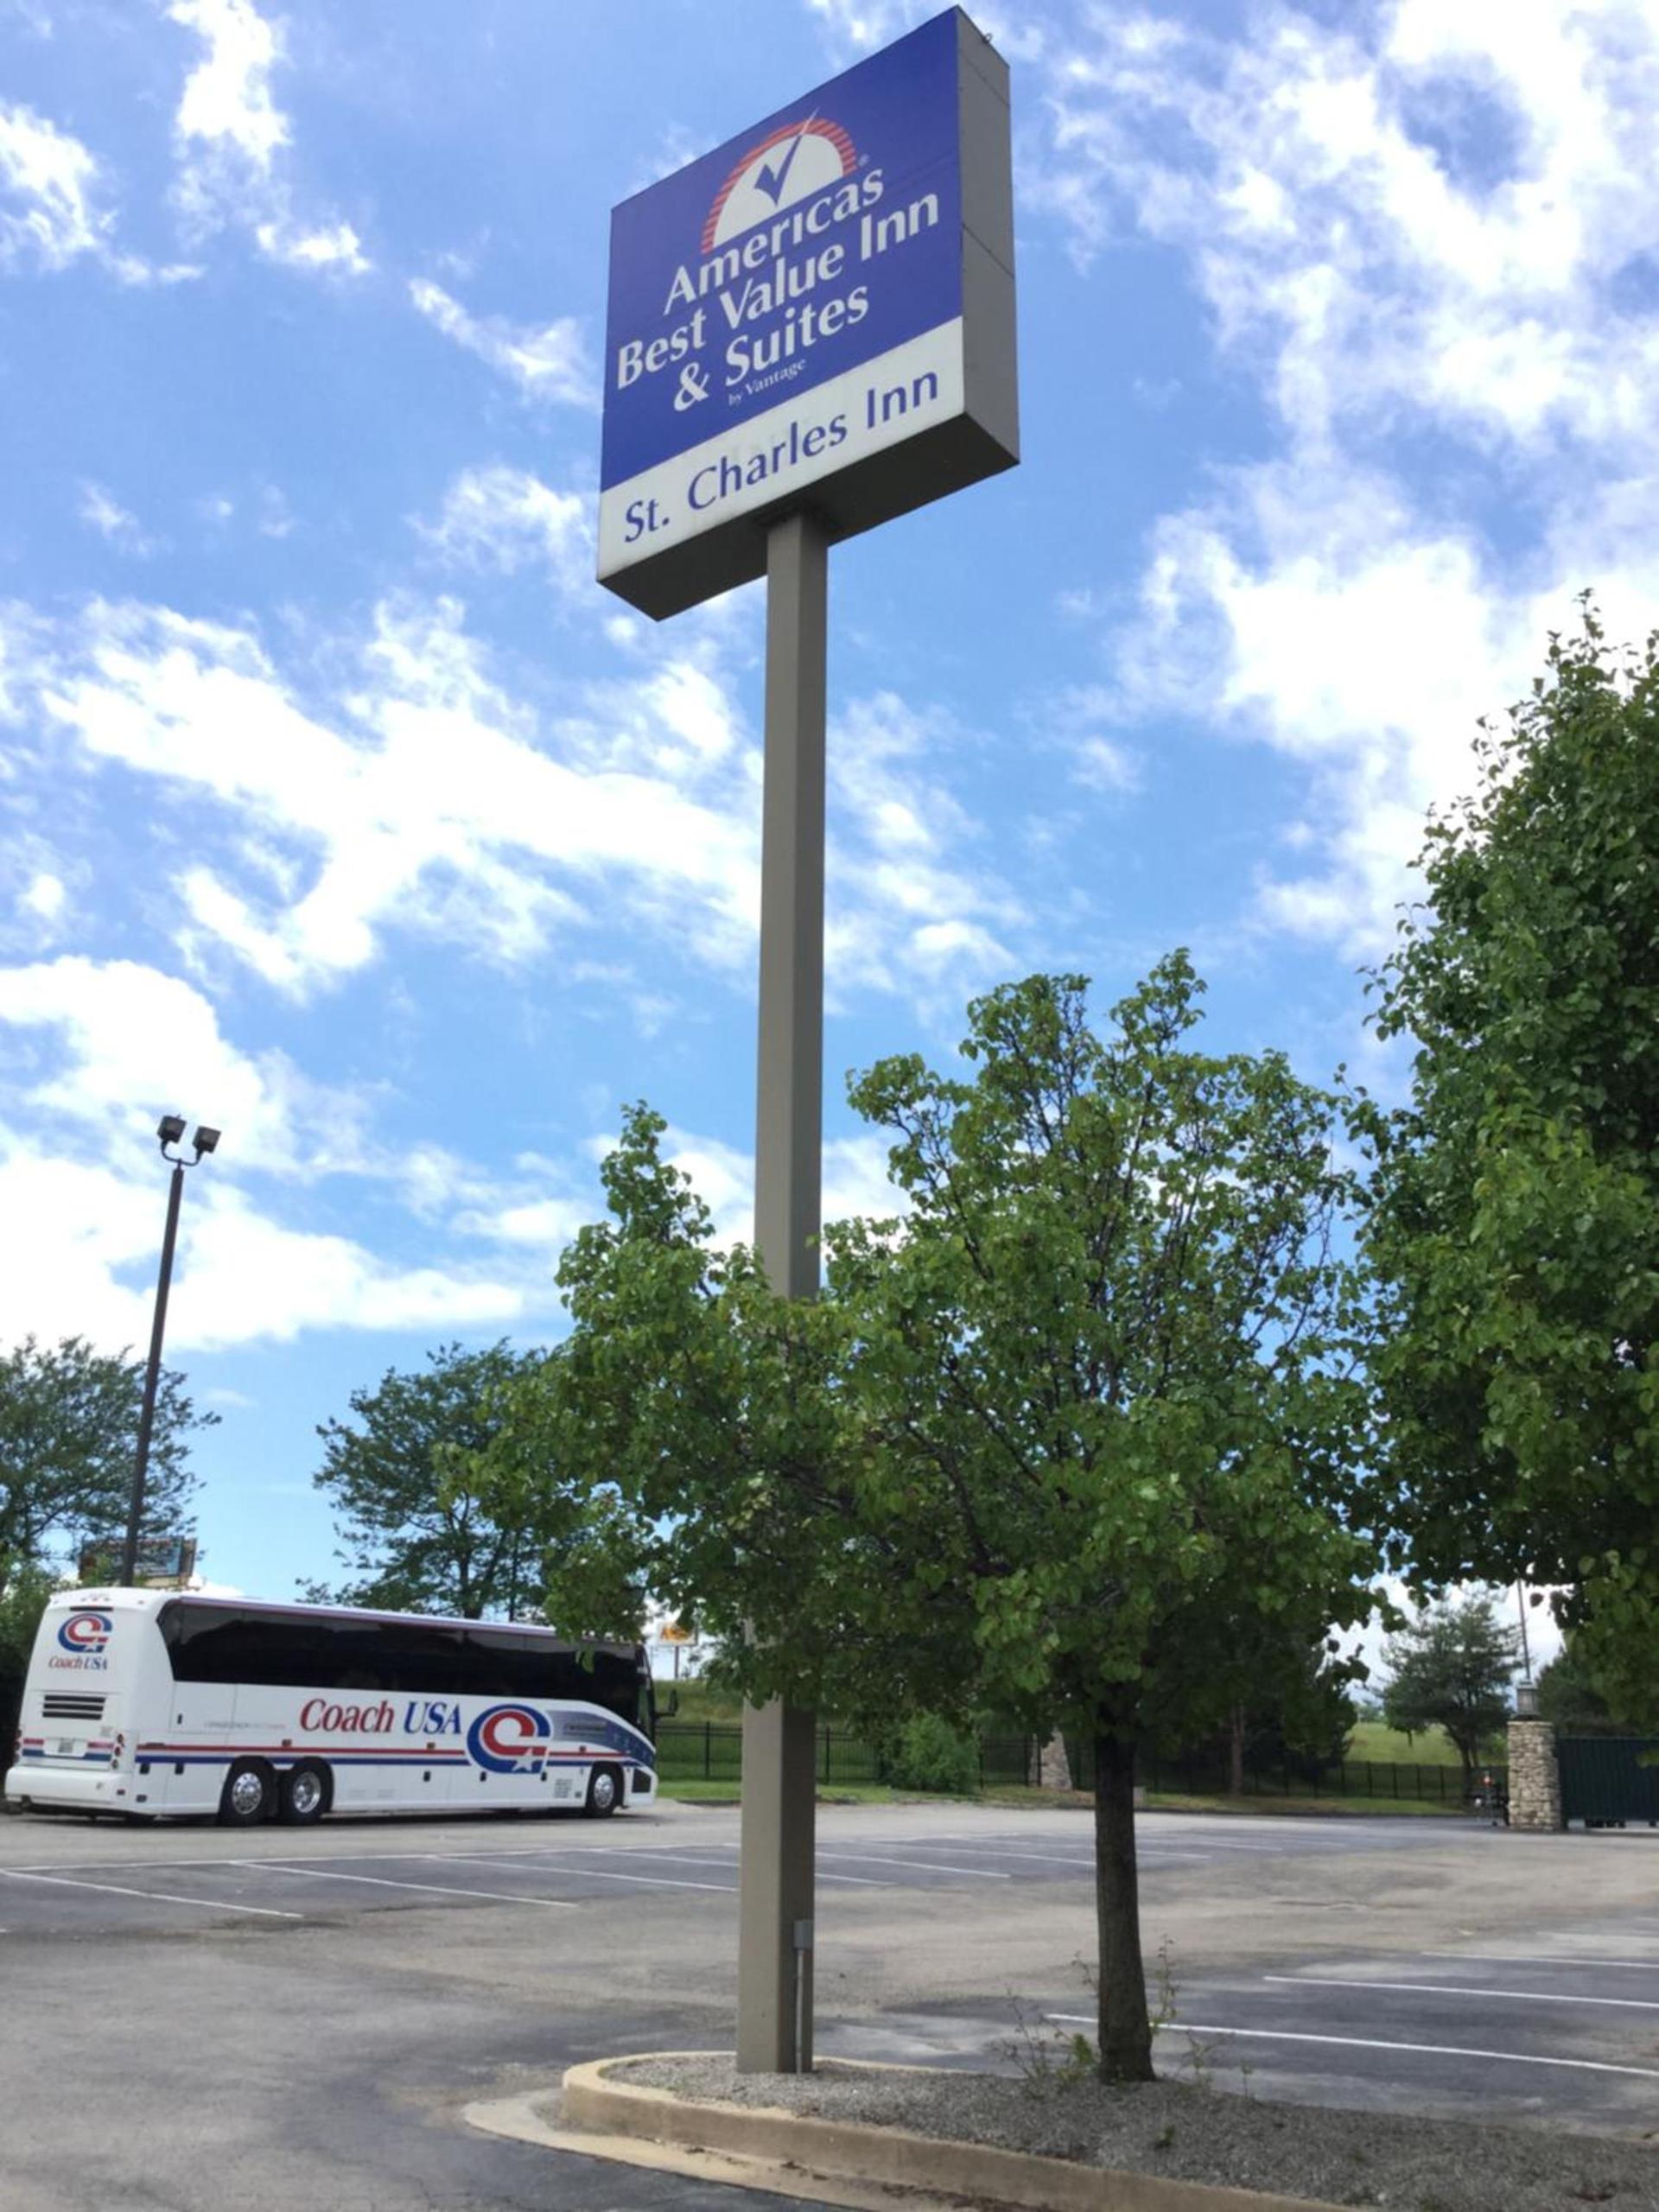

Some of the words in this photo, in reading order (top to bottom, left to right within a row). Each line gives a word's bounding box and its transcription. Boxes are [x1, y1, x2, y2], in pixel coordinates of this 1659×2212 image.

[618, 308, 707, 390] Best
[719, 245, 844, 329] Value
[861, 193, 938, 261] Inn
[664, 168, 884, 315] Americas
[673, 361, 709, 412] &
[724, 285, 868, 387] Suites
[728, 391, 743, 407] by
[745, 359, 806, 395] Vantage
[624, 499, 670, 543] St.
[688, 414, 848, 510] Charles
[867, 371, 938, 429] Inn
[48, 1656, 82, 1669] Coach
[84, 1656, 107, 1670] USA
[300, 1698, 395, 1733] Coach
[404, 1700, 462, 1735] USA
